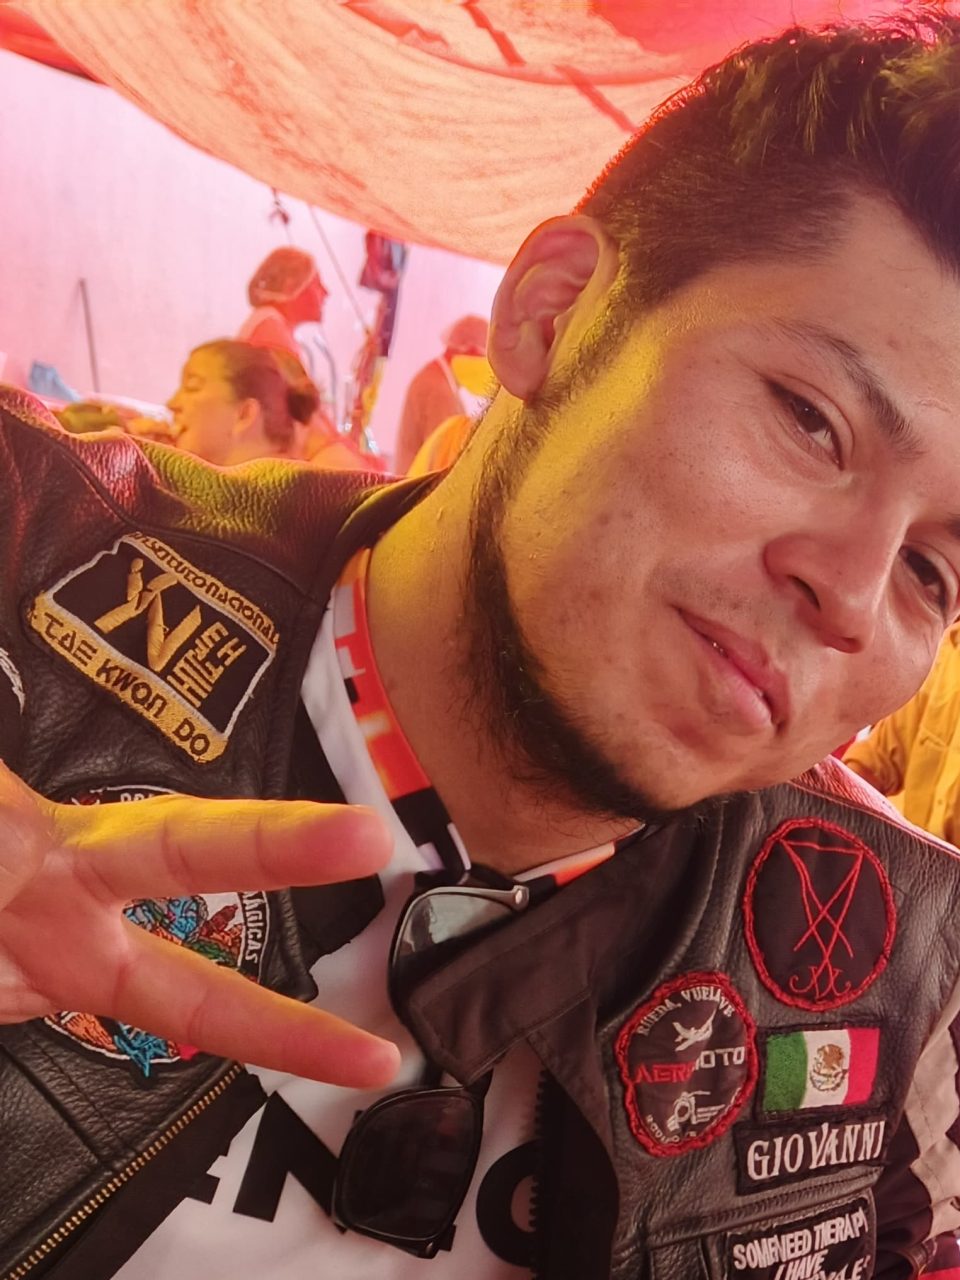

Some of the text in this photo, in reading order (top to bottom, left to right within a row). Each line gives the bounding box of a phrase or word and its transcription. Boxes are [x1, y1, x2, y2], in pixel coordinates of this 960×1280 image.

[43, 612, 98, 668] TAE
[95, 658, 168, 718] KWON
[172, 717, 212, 756] DO
[746, 1121, 886, 1181] GIOVANNI
